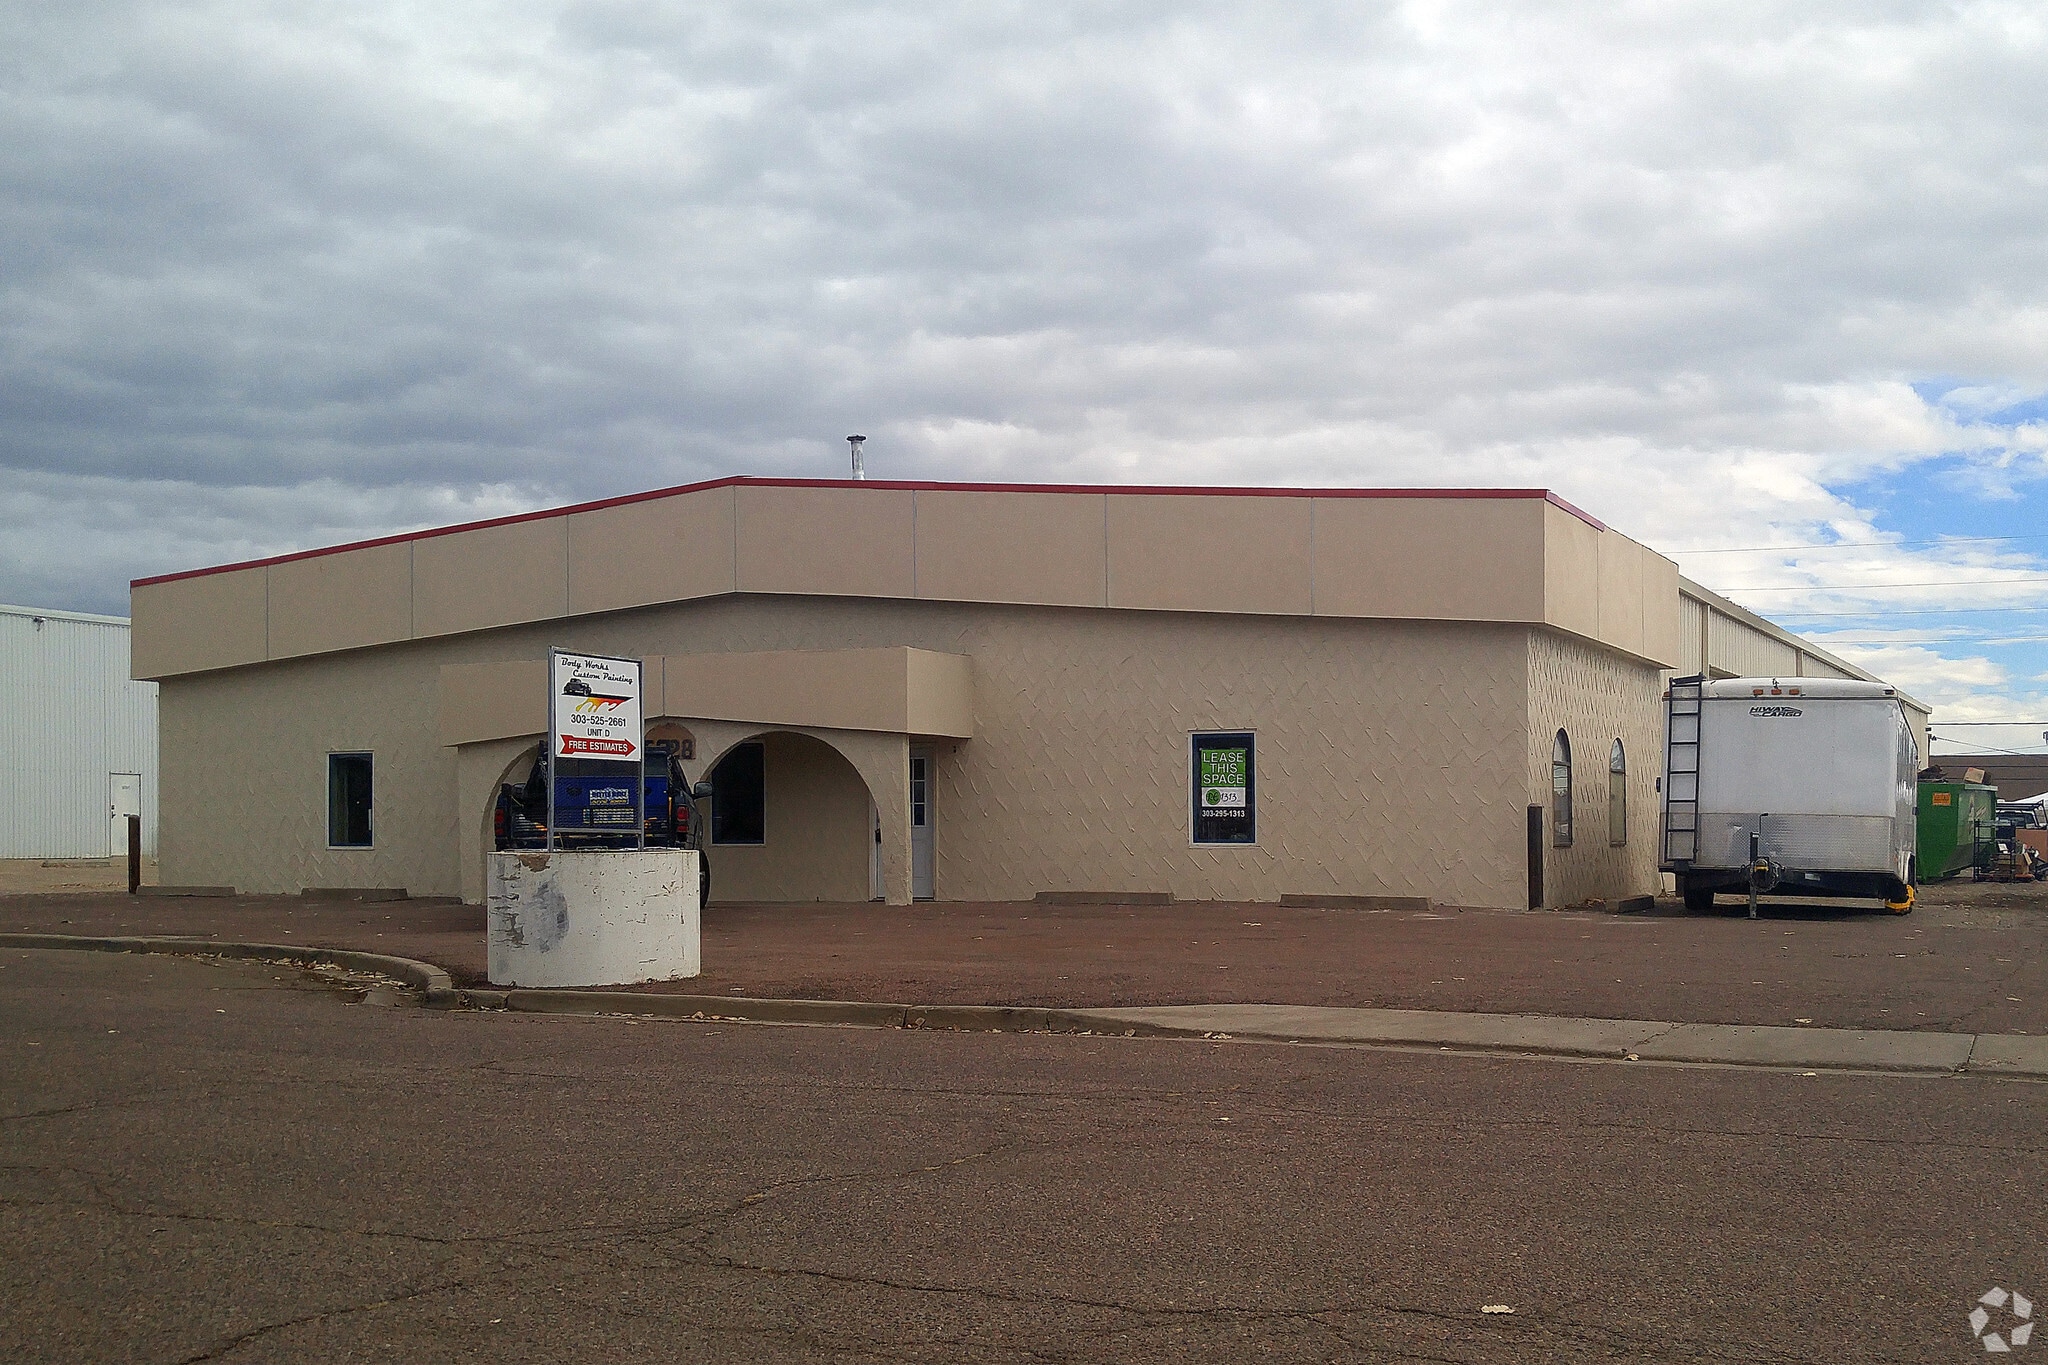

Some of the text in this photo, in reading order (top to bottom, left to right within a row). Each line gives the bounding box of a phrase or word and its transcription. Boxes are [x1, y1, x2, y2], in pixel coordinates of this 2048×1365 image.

[561, 657, 610, 671] Body Works
[572, 670, 633, 685] Custom Painting
[1749, 706, 1785, 714] HIWAY
[570, 713, 627, 727] 303-525-2661
[587, 728, 610, 737] UNIT D
[568, 740, 629, 752] FREE ESTIMATES
[1203, 752, 1244, 763] LEASE
[1209, 763, 1238, 773] THIS
[1203, 773, 1244, 784] SPACE
